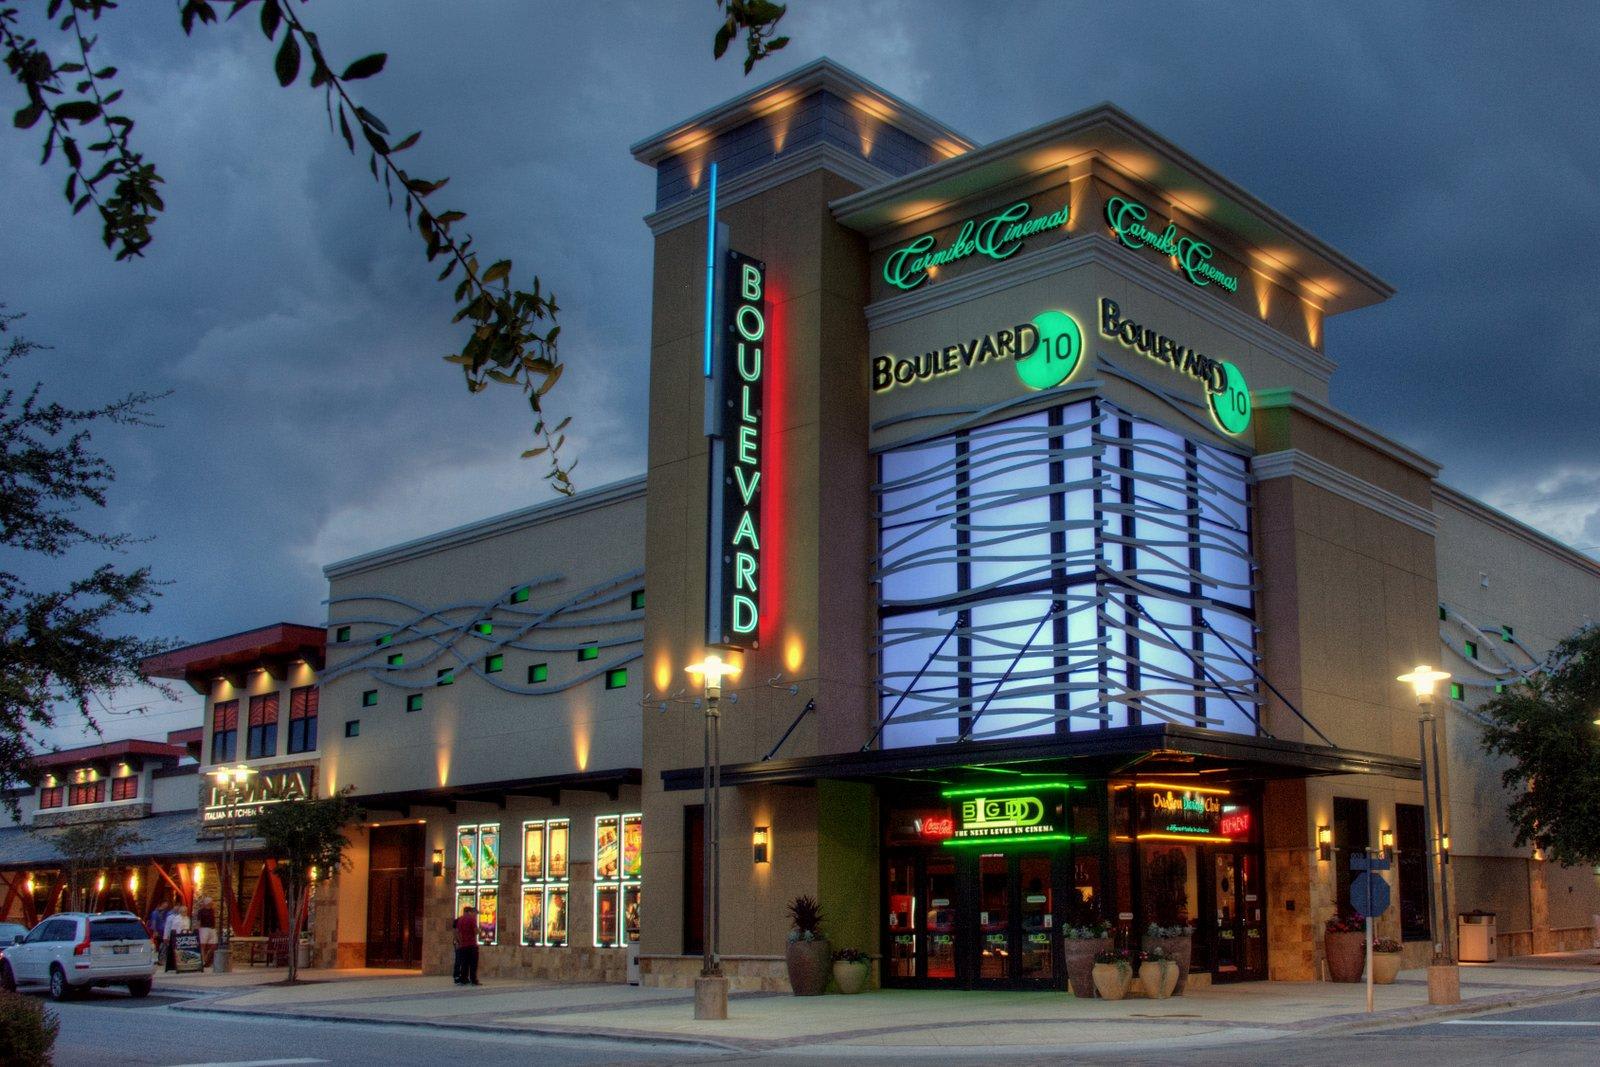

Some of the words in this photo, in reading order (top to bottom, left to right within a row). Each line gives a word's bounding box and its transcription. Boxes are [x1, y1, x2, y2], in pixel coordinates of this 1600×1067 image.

[883, 219, 975, 289] Carmike
[975, 202, 1069, 259] Cinemas
[1107, 196, 1177, 256] Carmike
[1178, 237, 1237, 292] Cinemas
[872, 323, 1040, 391] BOULEVARD
[1042, 333, 1072, 363] 10
[1100, 298, 1227, 394] BOULEVARD
[1229, 387, 1247, 416] 10
[732, 263, 764, 633] BOULEVARD
[228, 809, 257, 818] KTCHEN
[970, 829, 988, 837] NEXT
[1025, 824, 1054, 834] CINEMA
